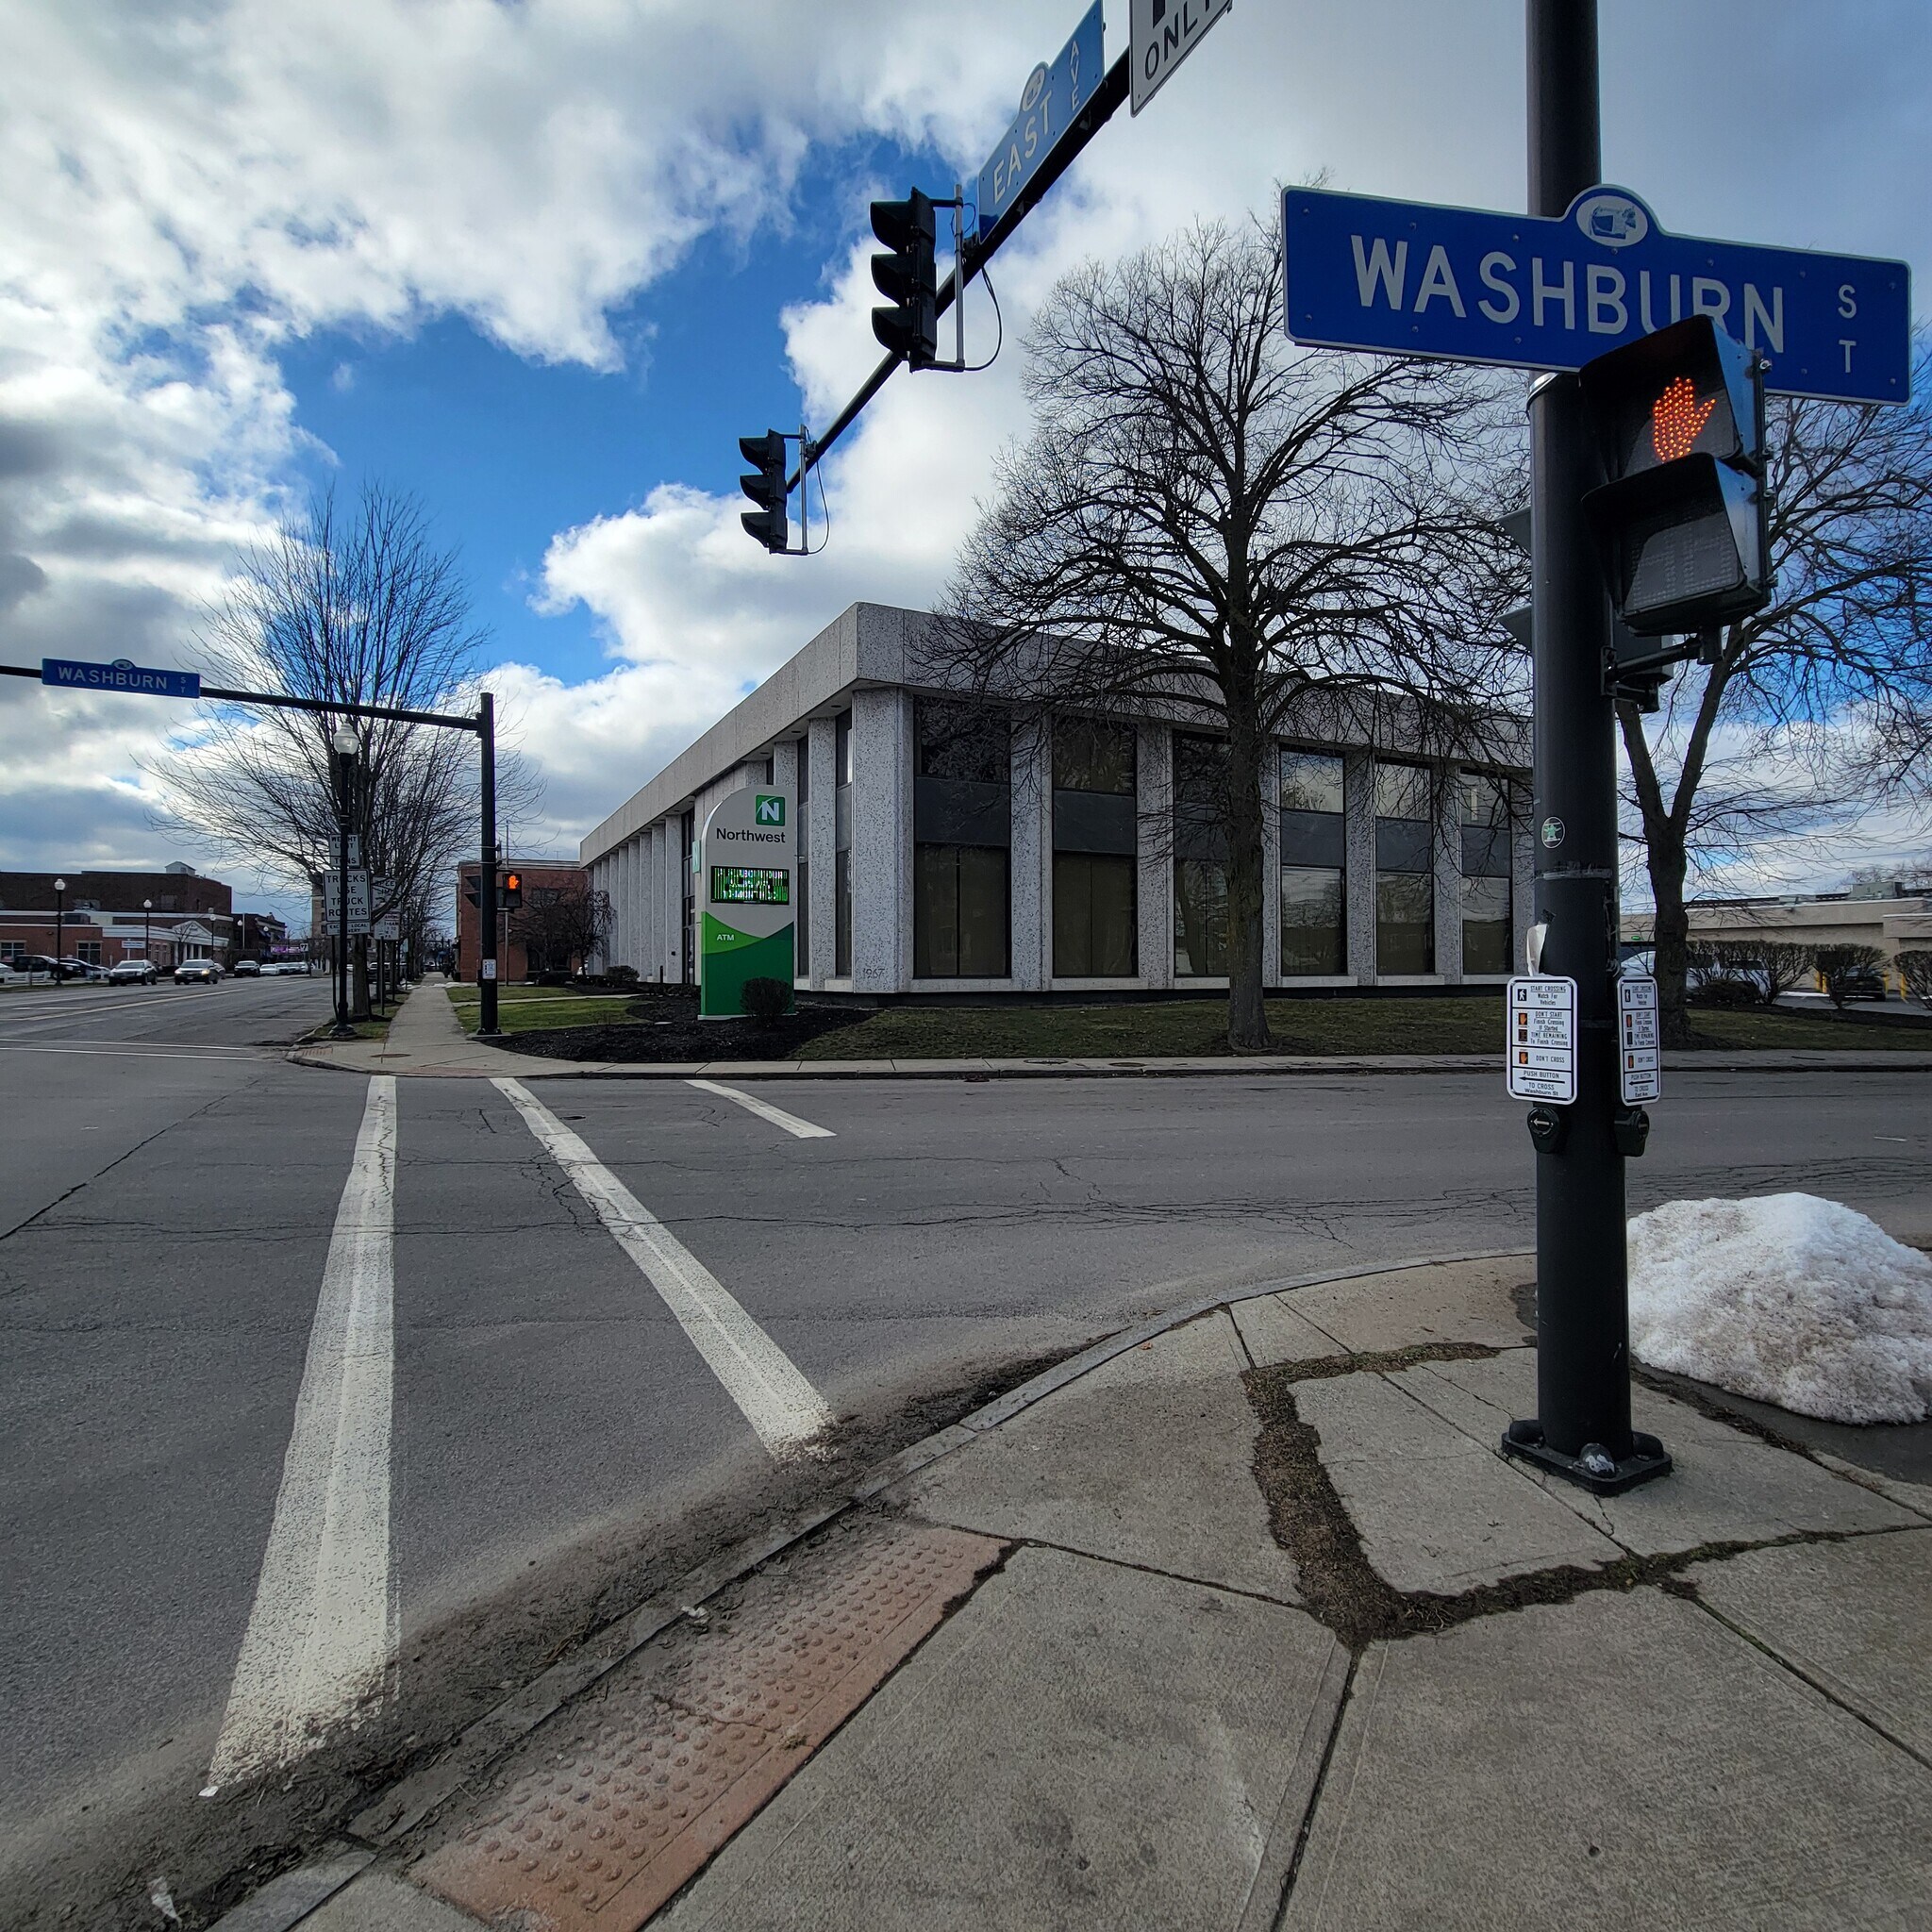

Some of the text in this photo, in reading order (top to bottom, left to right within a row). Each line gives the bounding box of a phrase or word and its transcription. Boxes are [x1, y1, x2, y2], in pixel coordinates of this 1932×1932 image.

[1145, 0, 1210, 81] ONL
[993, 41, 1079, 205] EAST AVE
[1350, 234, 1857, 374] WASHBURN ST
[58, 666, 186, 694] WASHBURN ST
[761, 801, 780, 821] N
[716, 827, 785, 843] Northwest
[329, 908, 367, 916] ROTES
